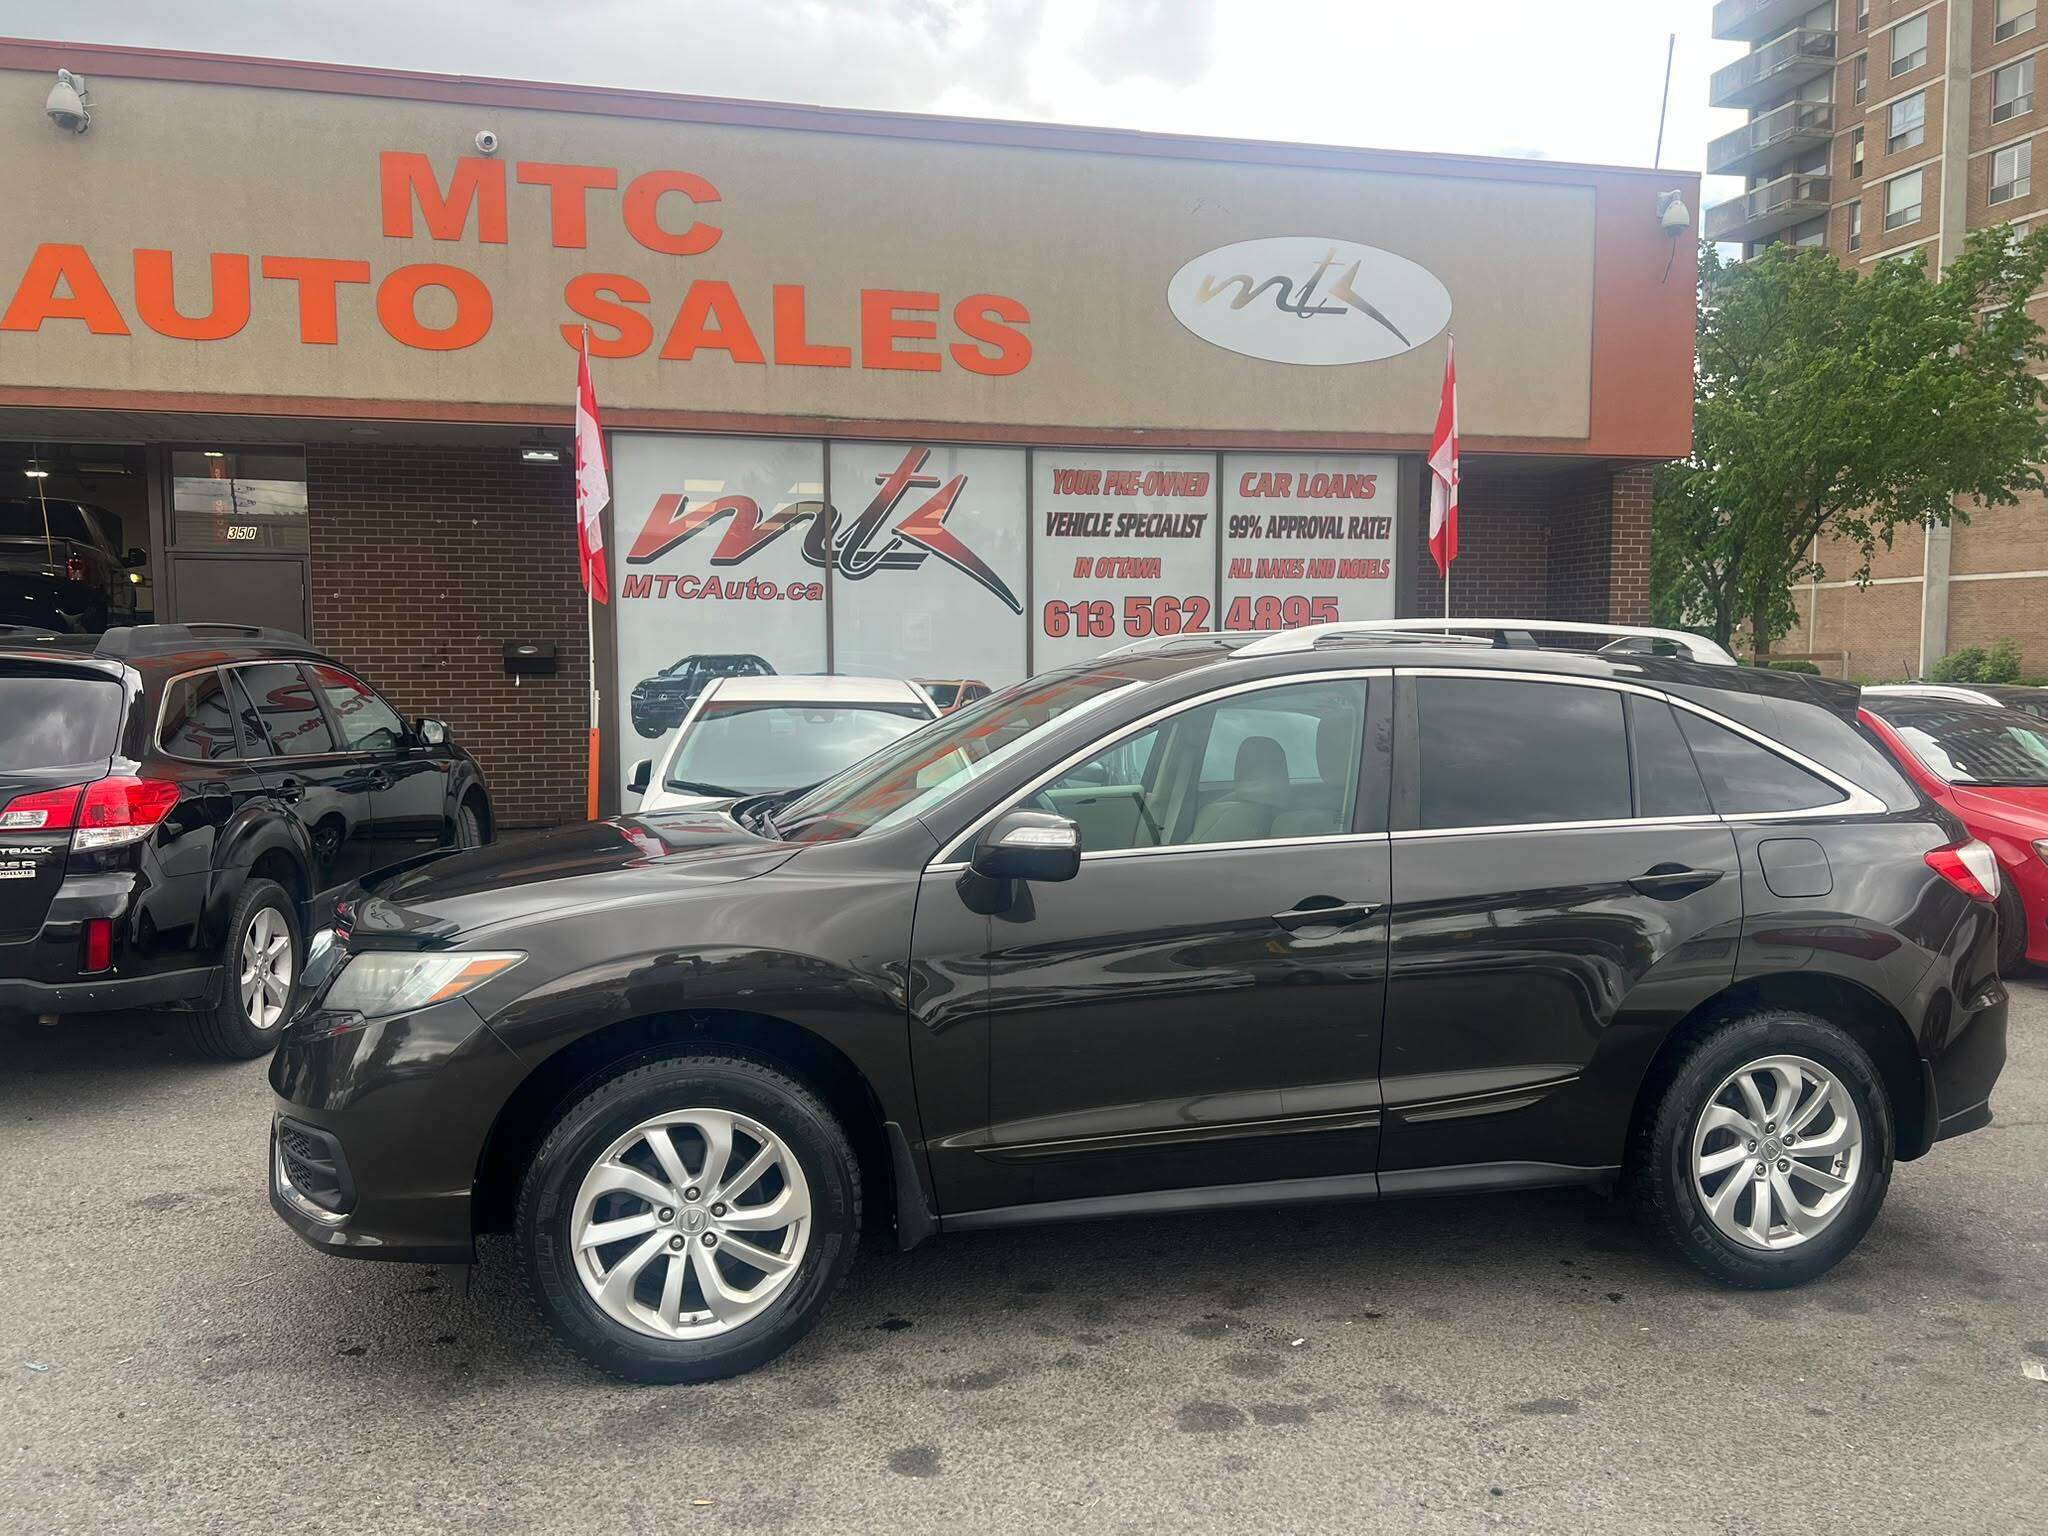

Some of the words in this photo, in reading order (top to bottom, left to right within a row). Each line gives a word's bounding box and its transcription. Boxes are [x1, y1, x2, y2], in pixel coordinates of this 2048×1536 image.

[380, 151, 724, 256] MTC
[0, 243, 493, 351] AUTO
[559, 272, 1033, 377] SALES
[1053, 469, 1102, 496] YOUR
[1103, 470, 1210, 497] PRE-OWNED
[1239, 472, 1293, 498] CAR
[1297, 472, 1377, 500] LOANS
[228, 527, 257, 539] 350
[1046, 511, 1114, 538] VEHICLE
[1114, 512, 1208, 538] SPECIALIST
[1228, 514, 1262, 539] 99%
[1265, 515, 1345, 540] APPROVAL
[1347, 515, 1392, 540] RATE!
[1073, 556, 1095, 579] IN
[1095, 556, 1162, 579] OTTAWA
[1228, 558, 1253, 579] ALL
[1255, 558, 1305, 579] MAKES
[1306, 558, 1336, 580] AND
[1337, 558, 1391, 580] MODELS
[621, 574, 824, 601] MTCAuto.ca
[1043, 599, 1115, 638] 613
[1123, 595, 1211, 638] 562
[1224, 595, 1340, 632] 4895
